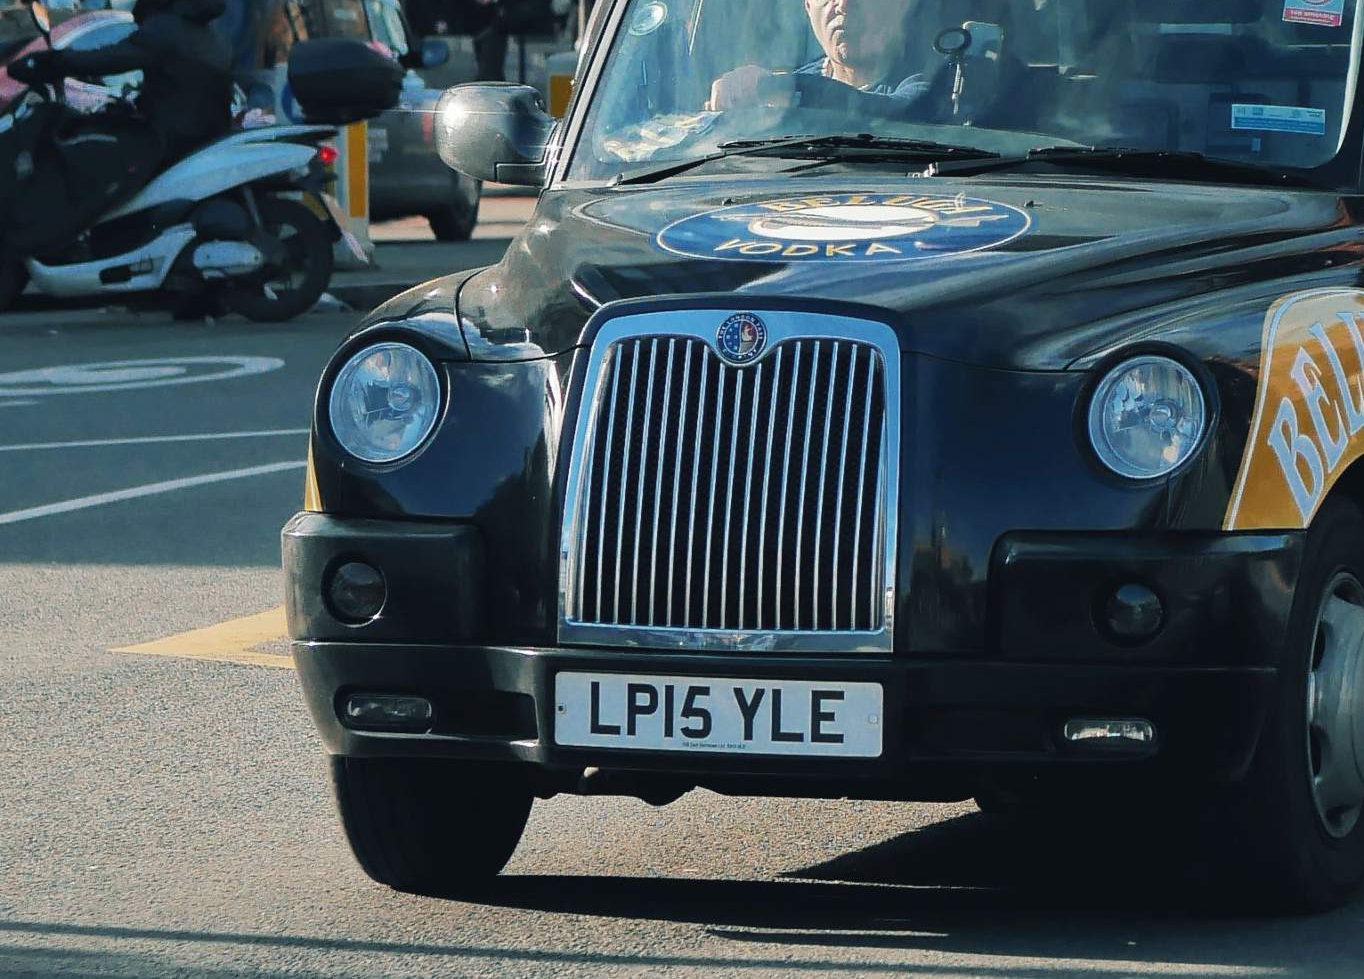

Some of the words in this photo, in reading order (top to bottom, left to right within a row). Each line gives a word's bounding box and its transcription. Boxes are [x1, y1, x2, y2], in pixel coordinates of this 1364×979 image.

[713, 238, 902, 257] VODKA
[590, 681, 712, 739] LP15
[733, 687, 845, 744] YLE
